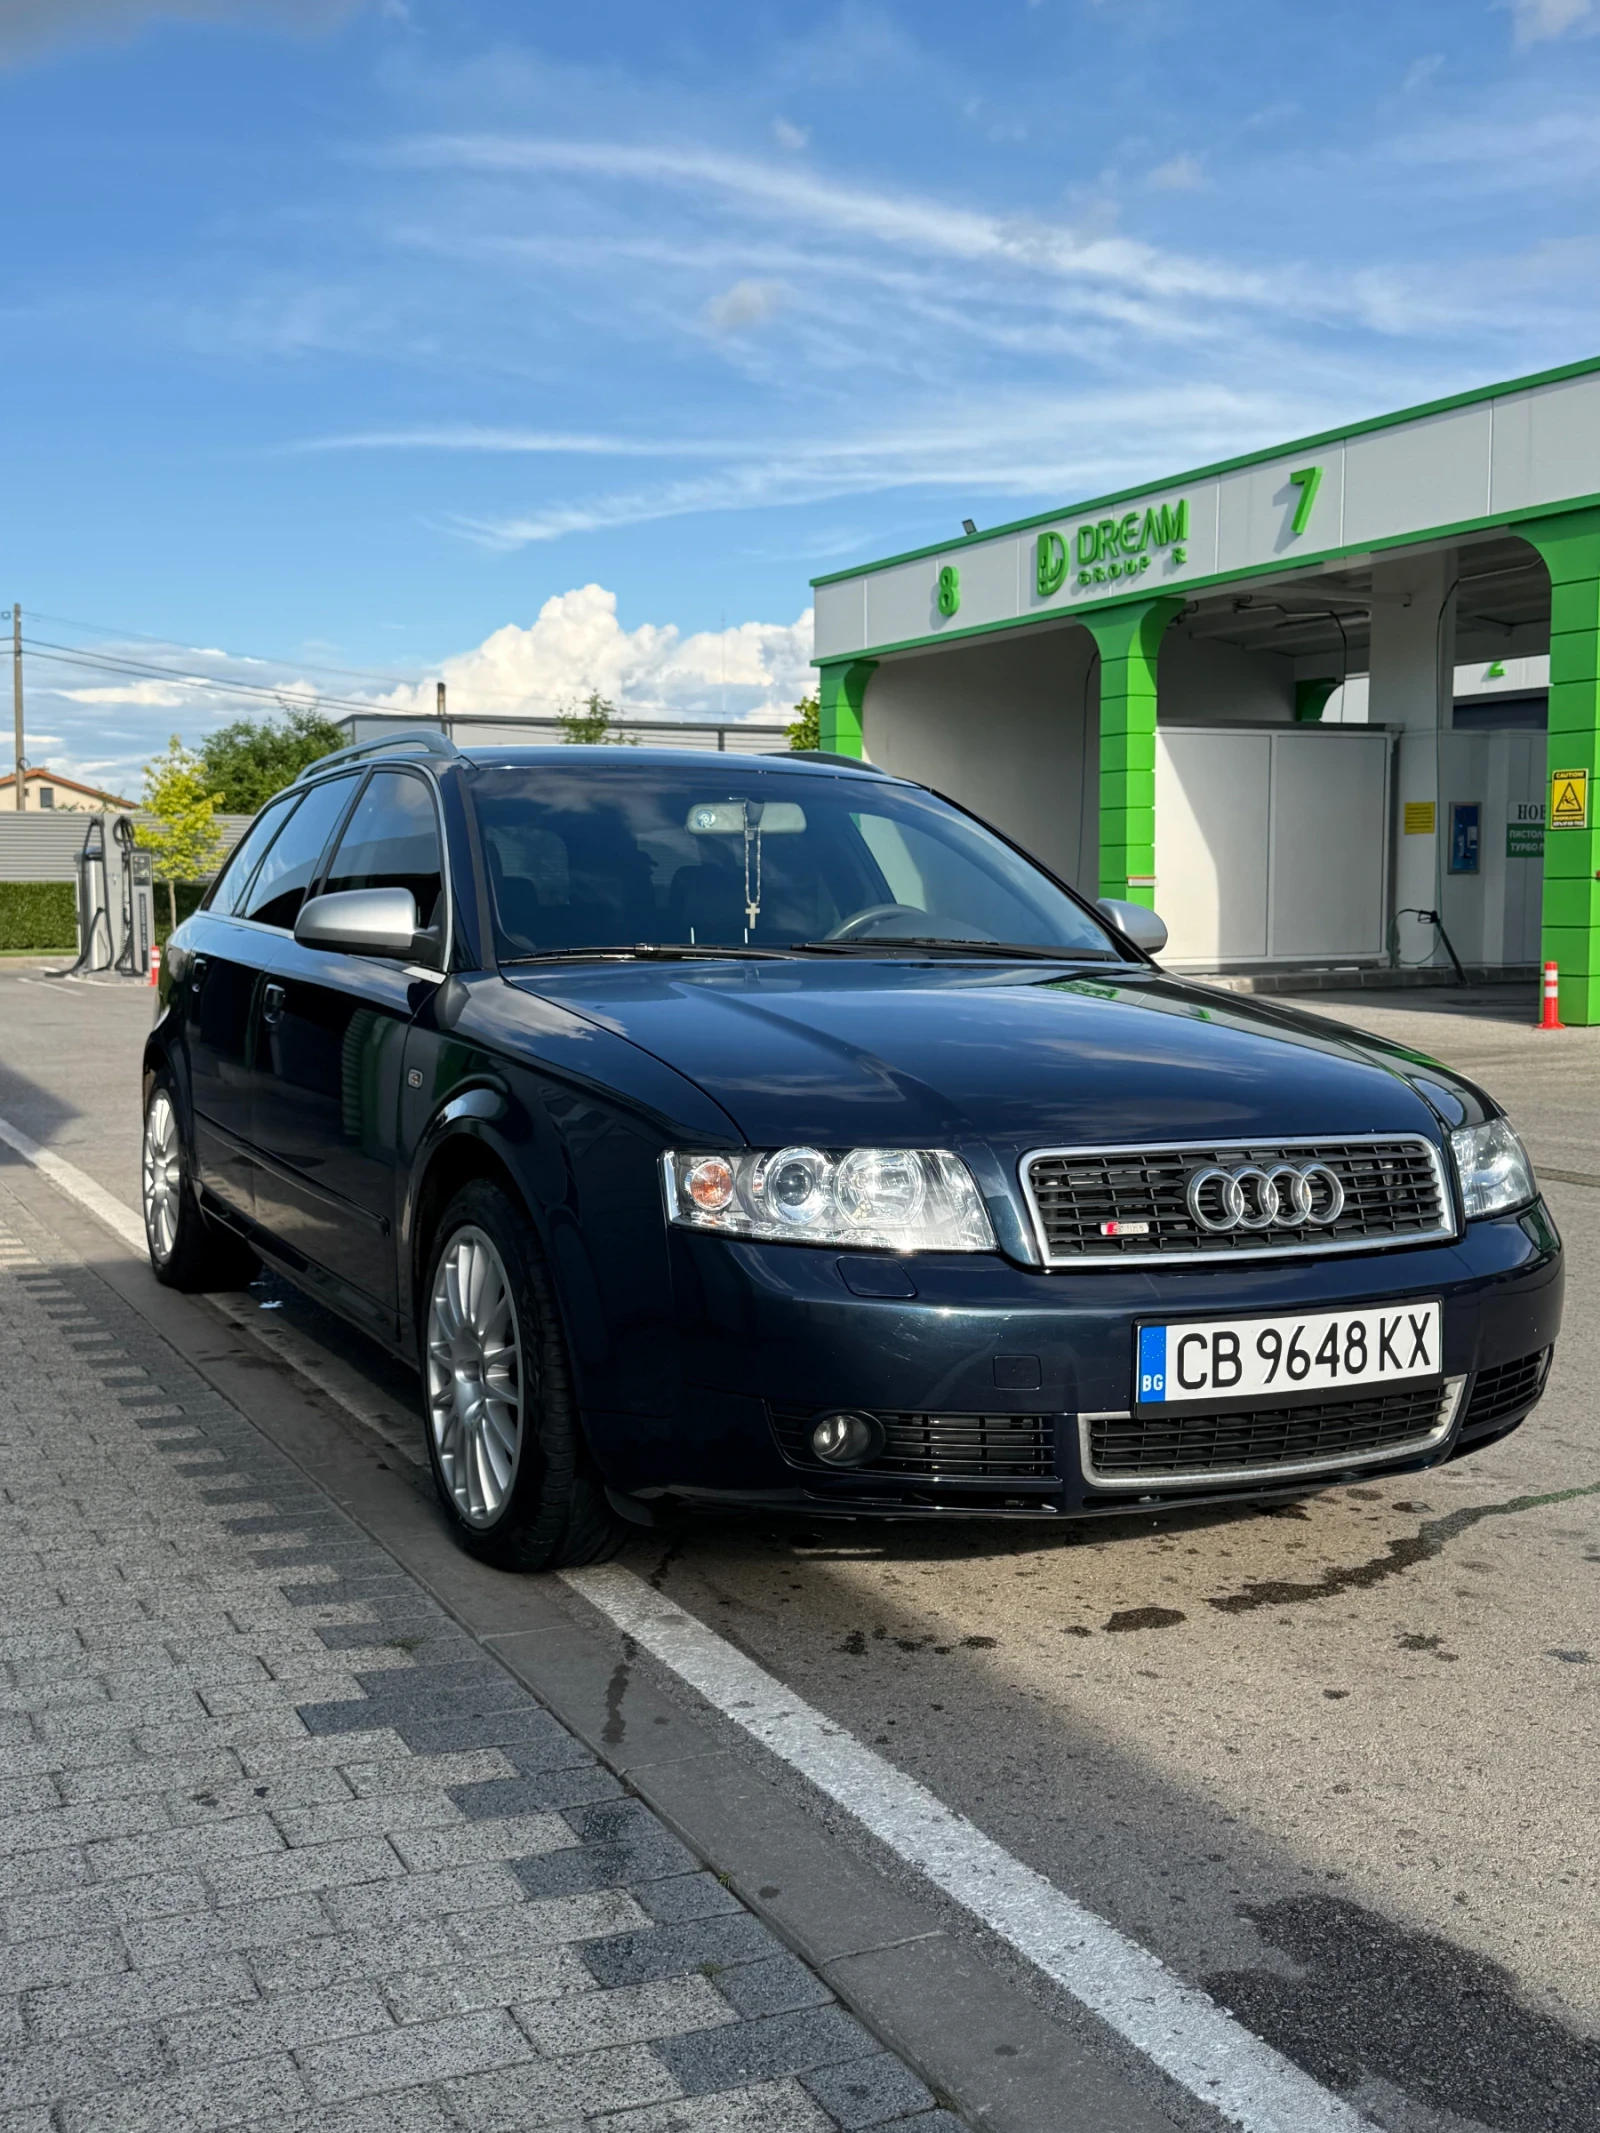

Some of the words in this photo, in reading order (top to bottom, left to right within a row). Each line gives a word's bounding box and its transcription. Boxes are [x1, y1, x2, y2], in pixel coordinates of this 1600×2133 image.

[1290, 466, 1323, 535] 7
[1078, 499, 1189, 565] DREAM
[938, 566, 960, 616] 8
[1078, 556, 1151, 586] GROUP
[1177, 1331, 1242, 1390] CB
[1256, 1320, 1368, 1385] 9648
[1379, 1312, 1431, 1372] KX
[1142, 1374, 1163, 1392] BG
